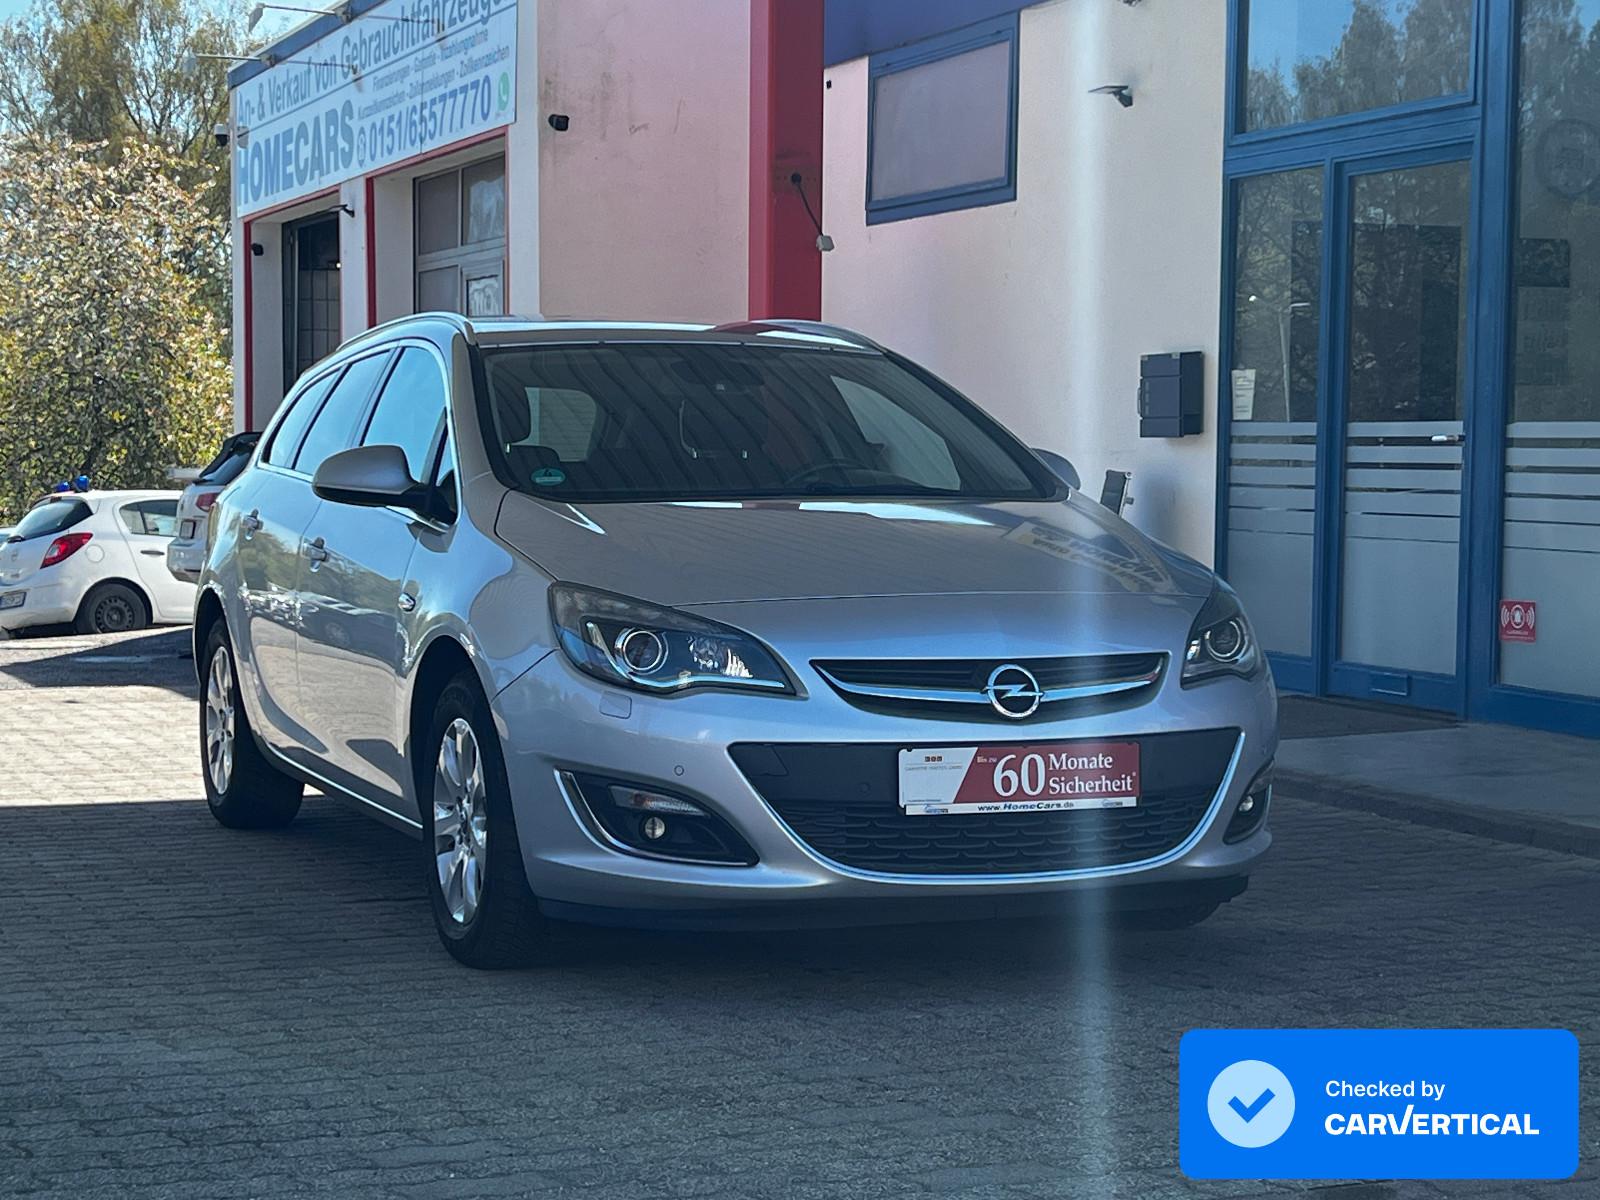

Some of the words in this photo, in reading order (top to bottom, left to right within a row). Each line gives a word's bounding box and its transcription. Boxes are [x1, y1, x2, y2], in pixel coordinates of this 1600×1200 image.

[258, 82, 266, 121] &
[268, 56, 312, 115] Verkauf
[314, 54, 337, 92] von
[341, 0, 501, 79] Gebrauchtfahrzeug
[237, 100, 354, 206] HOMECARS
[369, 75, 492, 162] 0151/65577770
[993, 752, 1046, 797] 60
[1048, 752, 1113, 771] Monate
